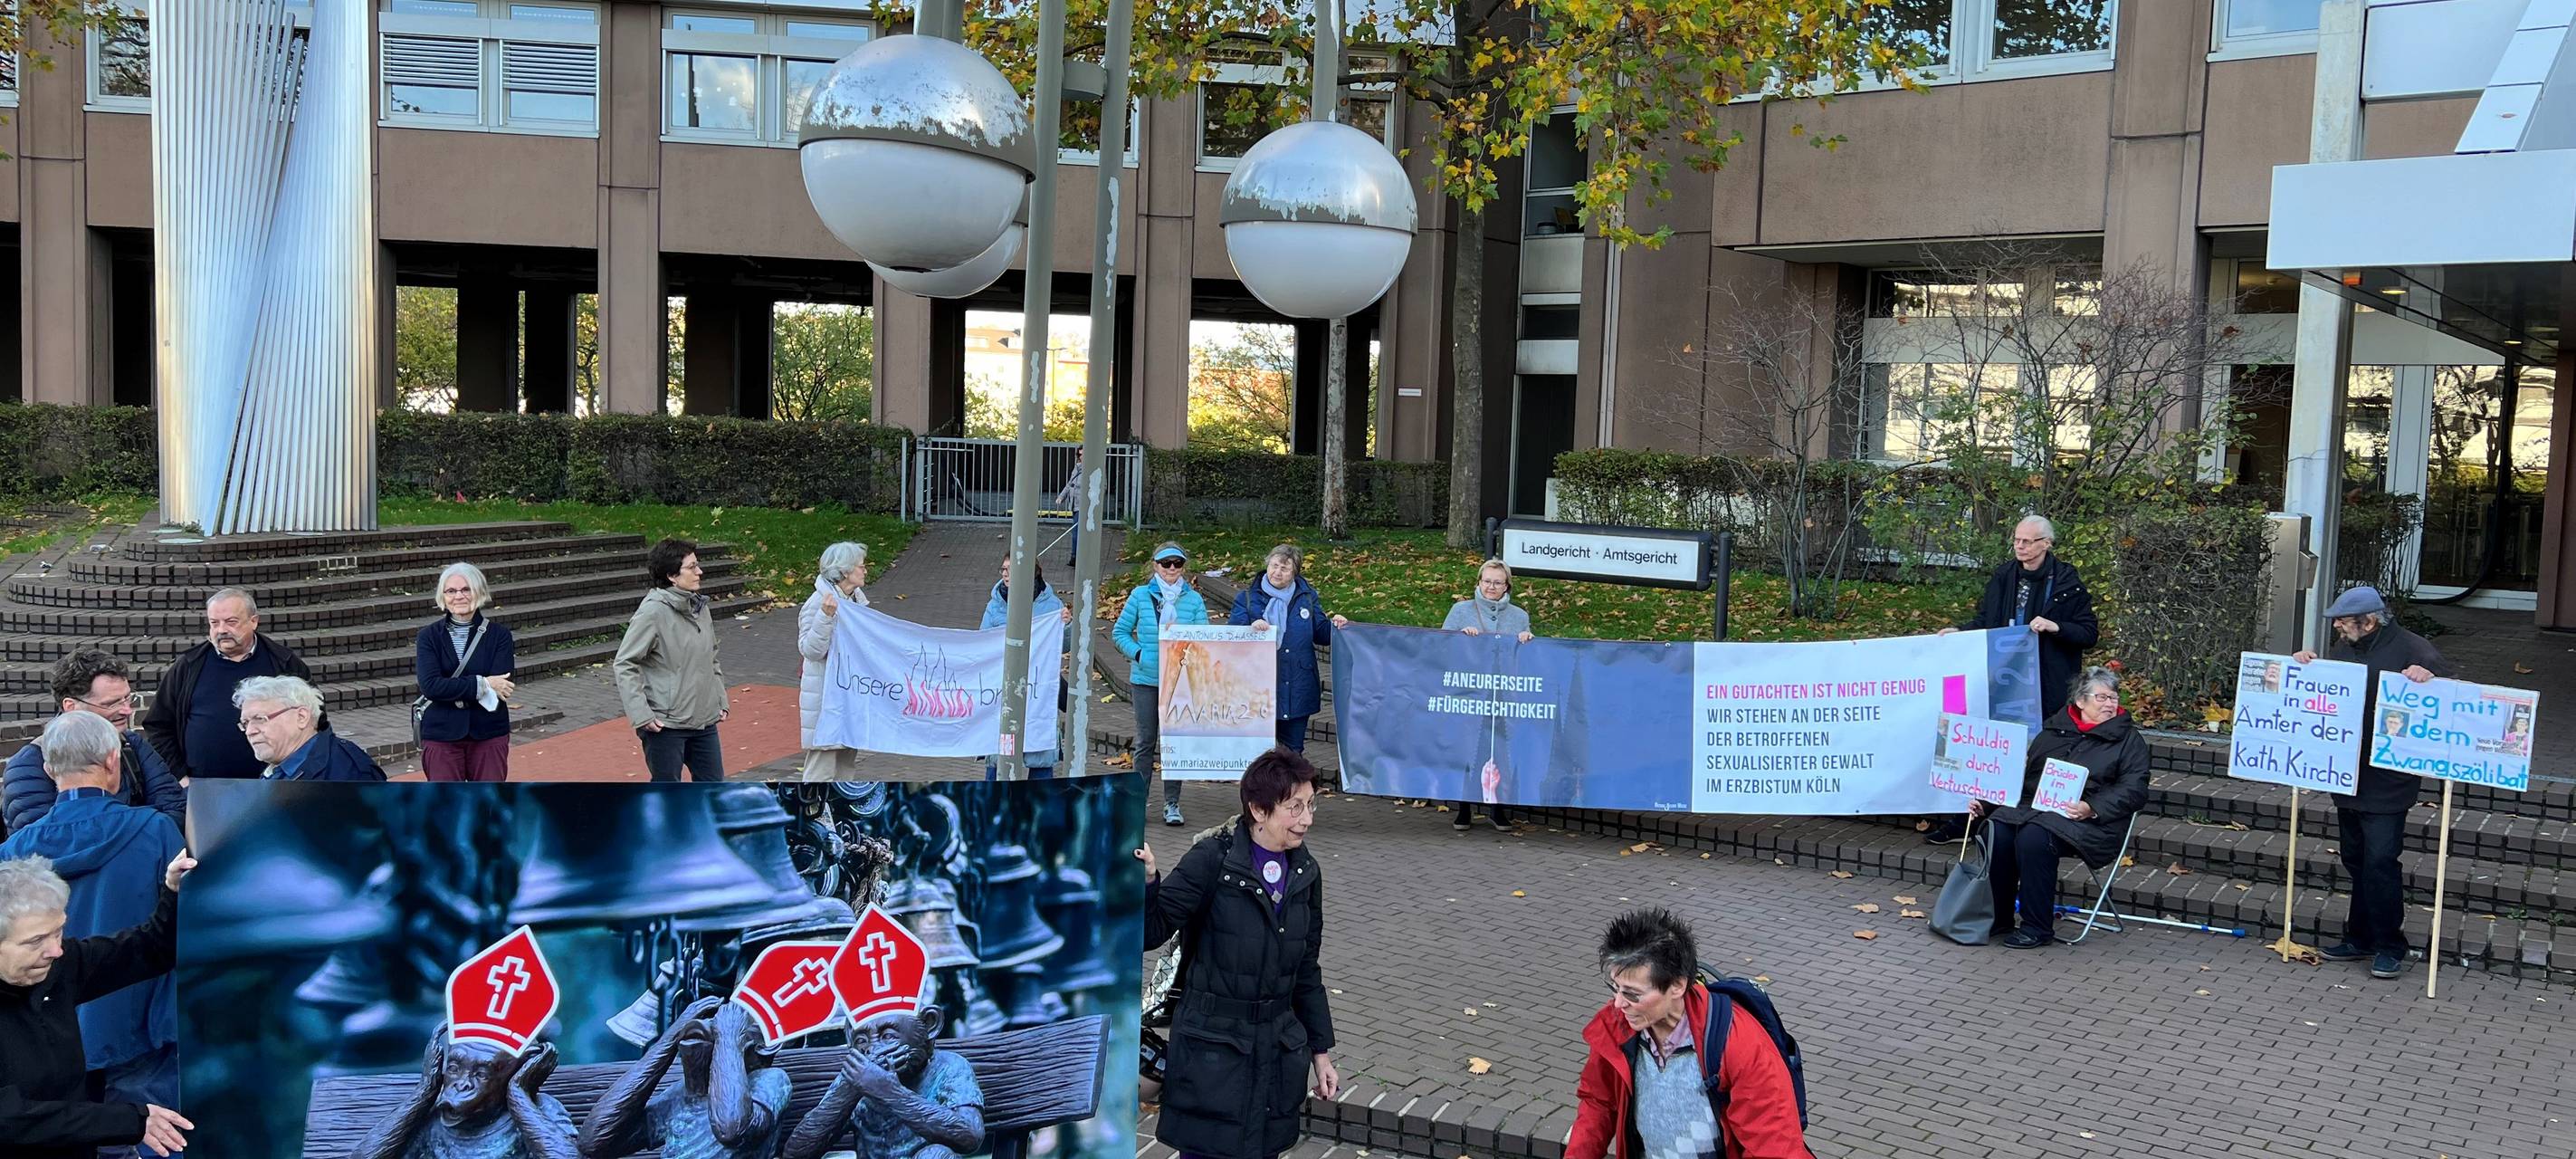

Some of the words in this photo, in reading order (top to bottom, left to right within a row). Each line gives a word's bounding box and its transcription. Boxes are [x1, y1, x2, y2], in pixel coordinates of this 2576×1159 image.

[1522, 541, 1591, 558] Landgericht
[1603, 548, 1678, 565] Amtsgericht
[836, 652, 903, 701] Unsere
[1443, 671, 1543, 693] #ANEURERSEITE
[2285, 666, 2350, 696] Frauen
[1706, 685, 1728, 699] EIN
[1732, 685, 1808, 699] GUTACHTEN
[1812, 684, 1833, 698] IST
[1837, 681, 1877, 697] NICHT
[1881, 679, 1926, 696] GENUG
[2381, 680, 2439, 719] Weg
[2452, 700, 2498, 715] mit
[1427, 694, 1557, 719] #FÜRGERECHTIGKEIT
[1707, 708, 1732, 723] WIR
[1736, 708, 1787, 723] STEHEN
[1791, 708, 1808, 723] AN
[1813, 707, 1839, 723] DER
[1844, 705, 1881, 722] SEITE
[2284, 694, 2299, 707] in
[2304, 694, 2338, 714] alle
[2234, 704, 2302, 733] Ämter
[2311, 716, 2353, 742] der
[2409, 719, 2470, 746] dem
[1707, 732, 1732, 747] DER
[1736, 732, 1829, 747] BETROFFENEN
[1951, 723, 2009, 755] Schuldig
[1706, 755, 1818, 771] SEXUALISIERTER
[1821, 753, 1875, 770] GEWALT
[1966, 753, 2000, 775] durch
[2046, 762, 2078, 780] Brüder
[2285, 746, 2352, 787] Kirche
[2372, 733, 2528, 789] Zwangszölibat
[1706, 778, 1722, 793] IM
[1726, 778, 1801, 794] ERZBISTUM
[1807, 775, 1841, 793] KÖLN
[1931, 771, 2007, 803] Vertuschung
[2051, 778, 2066, 790] im
